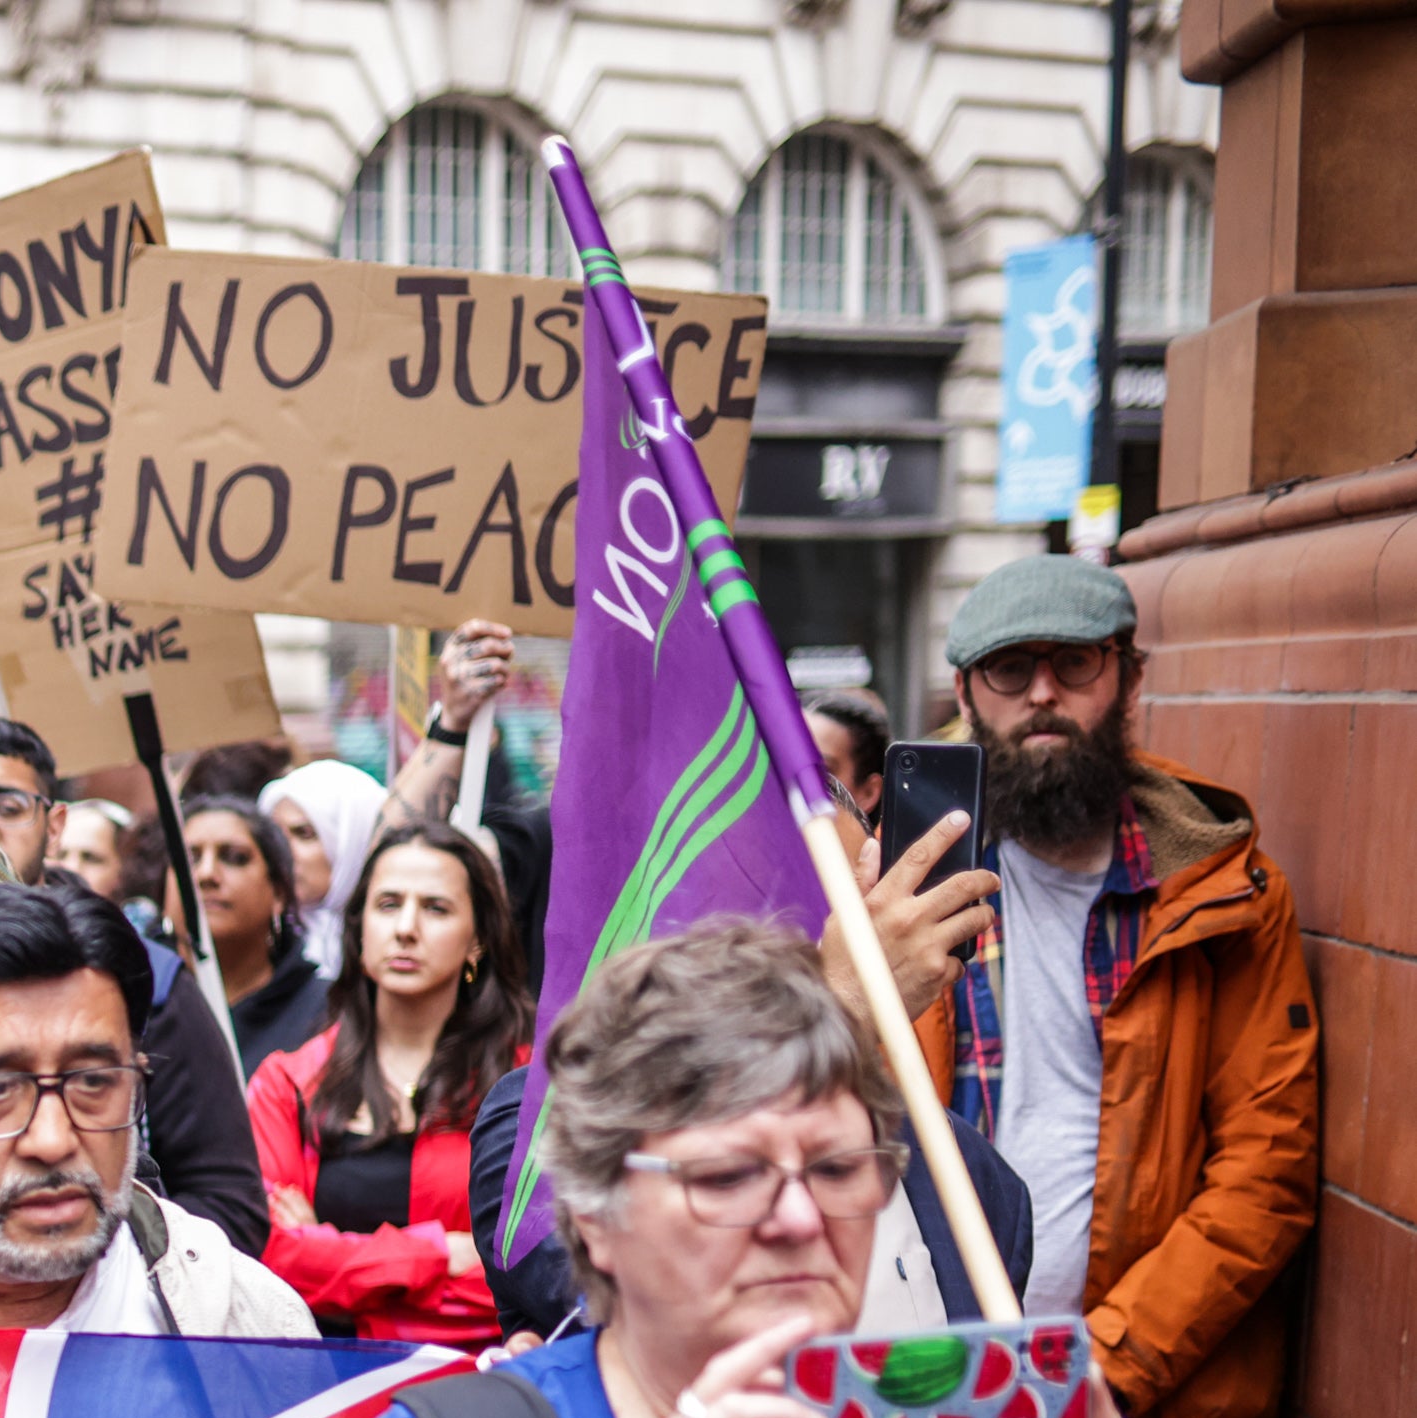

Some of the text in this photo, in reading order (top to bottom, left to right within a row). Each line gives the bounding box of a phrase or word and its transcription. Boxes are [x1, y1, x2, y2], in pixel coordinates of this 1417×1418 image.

[154, 278, 333, 392] NO
[388, 276, 769, 438] JUSCE
[127, 457, 290, 581] NO
[23, 551, 94, 619] SAY
[88, 616, 189, 679] NAME
